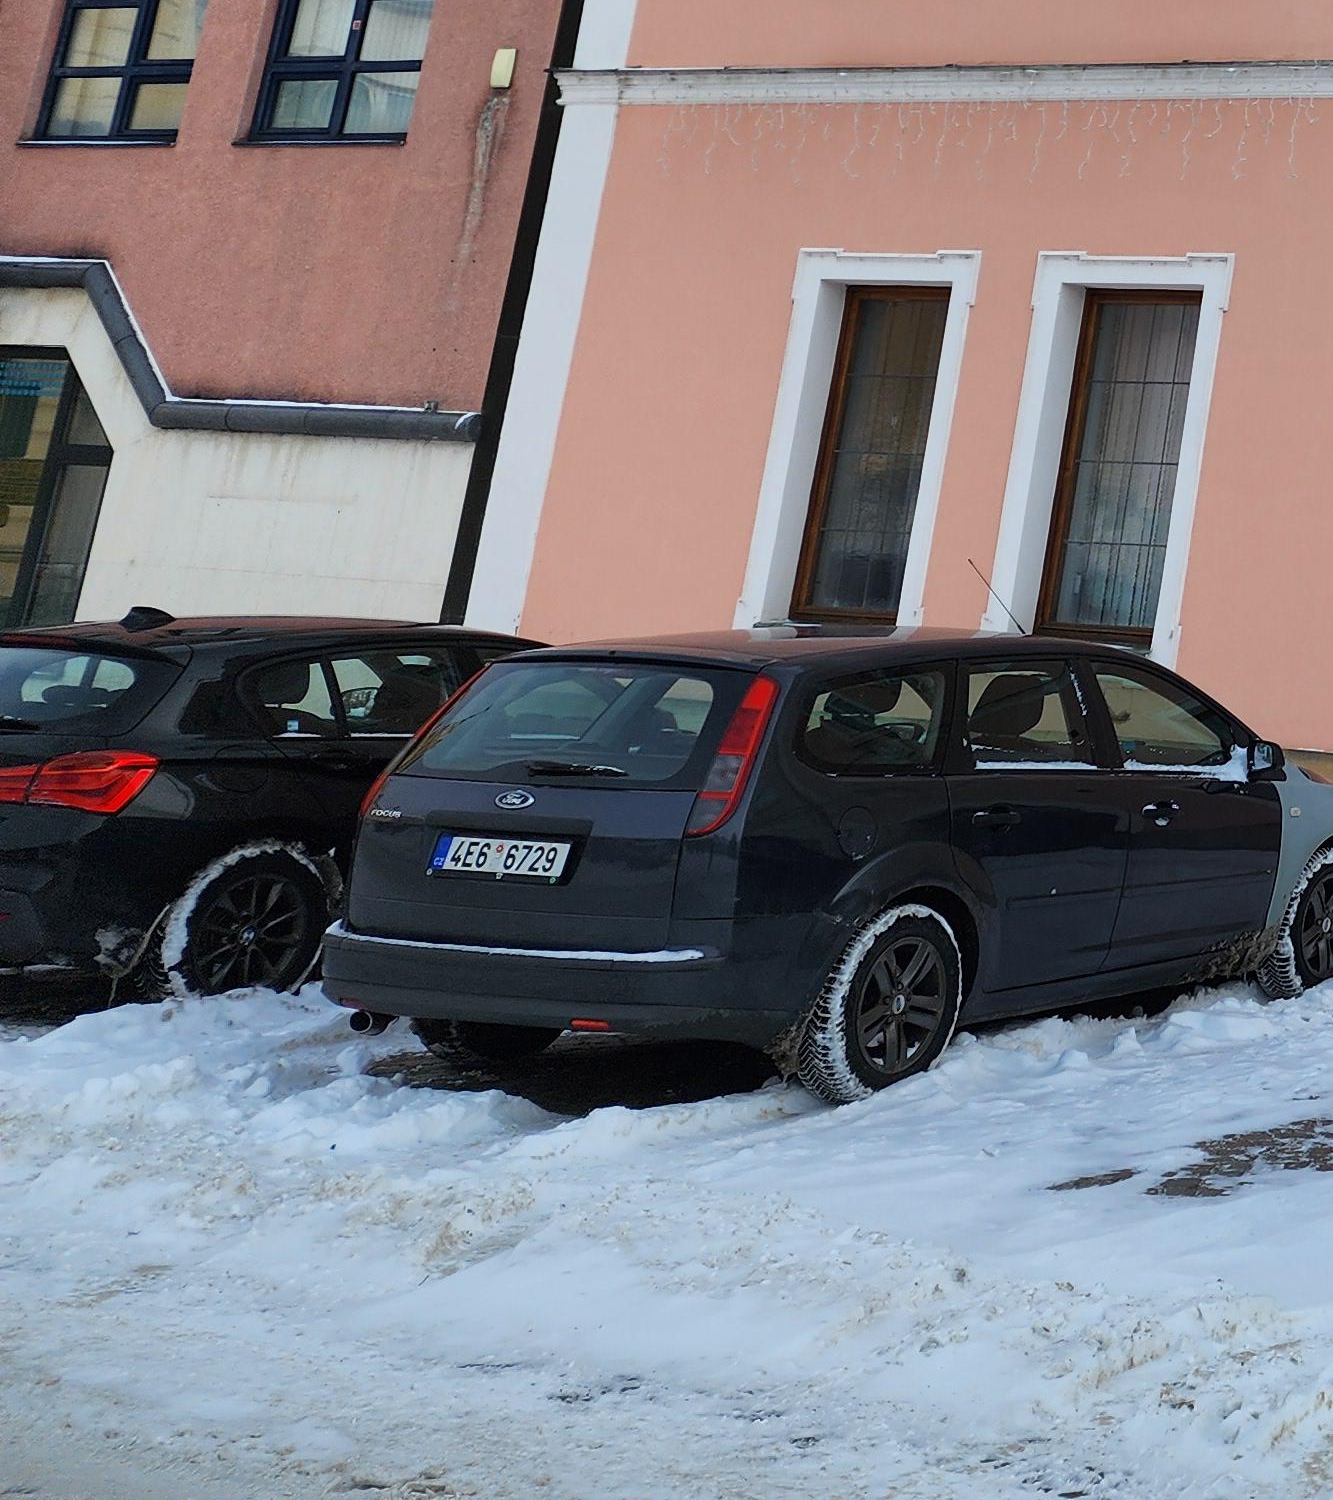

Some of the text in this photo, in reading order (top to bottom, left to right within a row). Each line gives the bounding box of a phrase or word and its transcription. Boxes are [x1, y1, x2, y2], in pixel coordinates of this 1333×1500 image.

[370, 808, 402, 819] FOCUS
[450, 841, 558, 873] 4E6 6729
